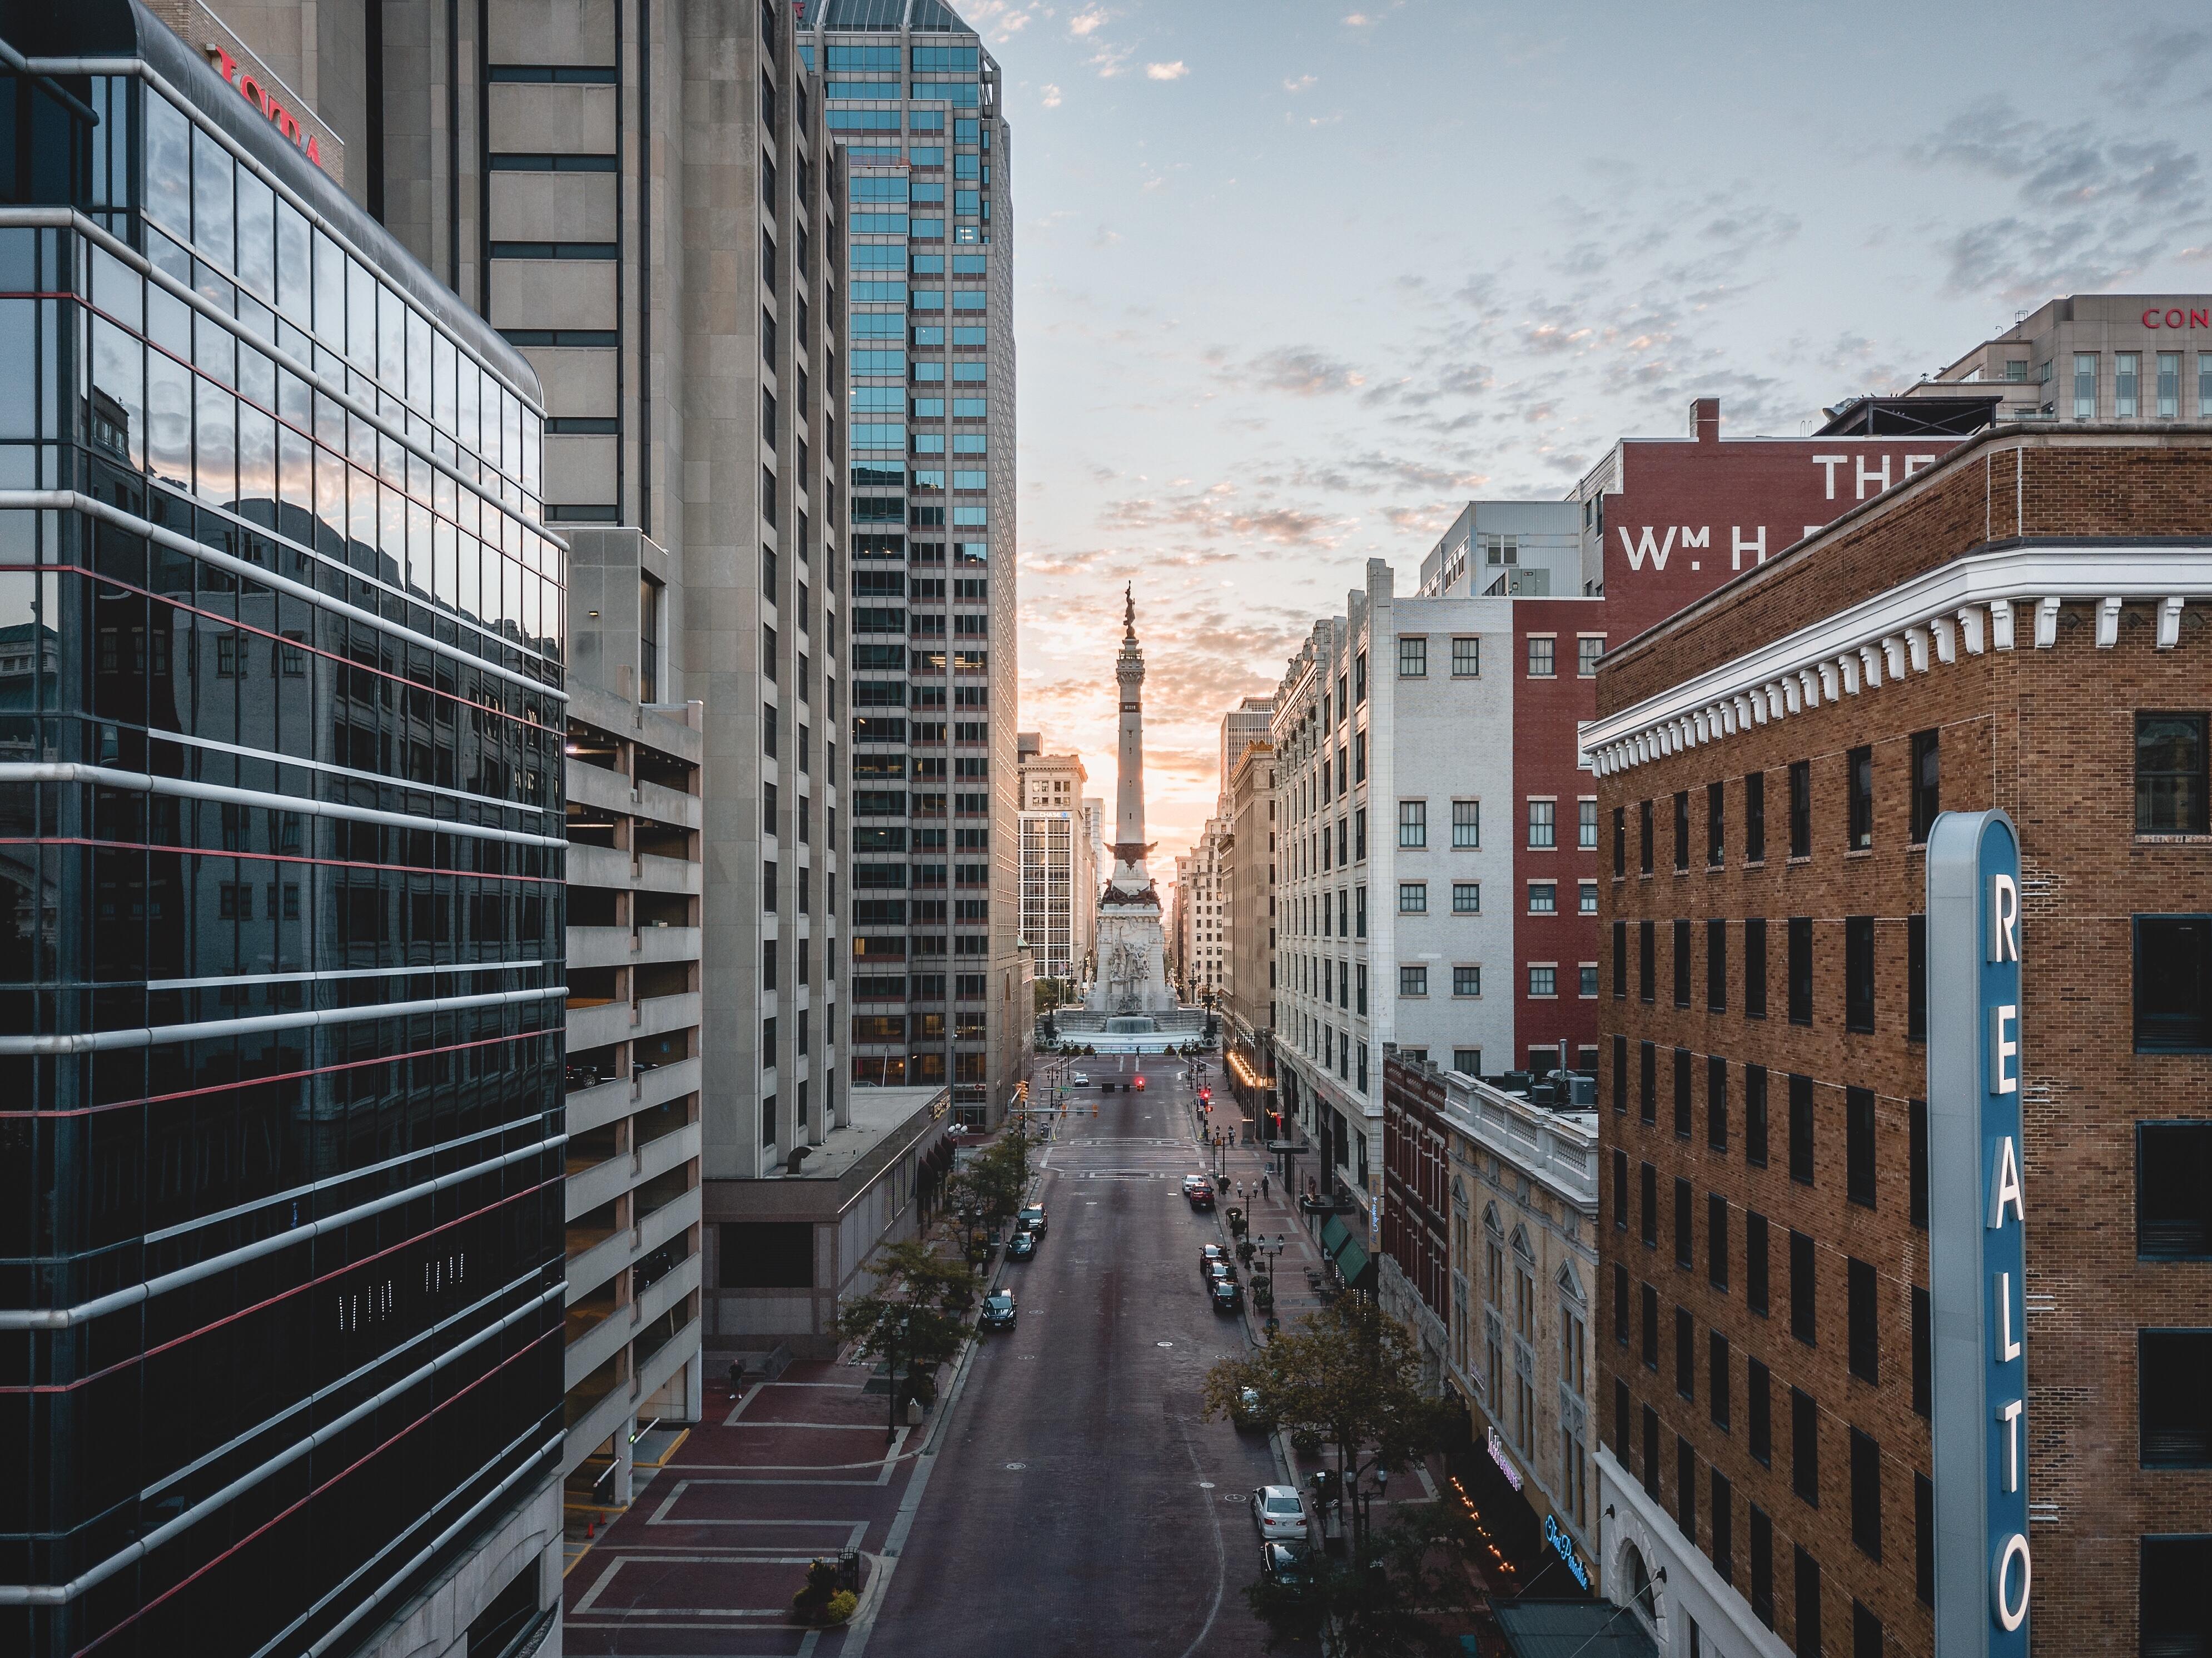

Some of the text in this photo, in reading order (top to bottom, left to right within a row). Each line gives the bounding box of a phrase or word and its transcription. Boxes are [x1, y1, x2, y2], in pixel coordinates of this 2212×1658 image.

[2143, 308, 2209, 329] CON
[1991, 874, 2031, 1631] REALTO
[1560, 1534, 1588, 1591] Paradise
